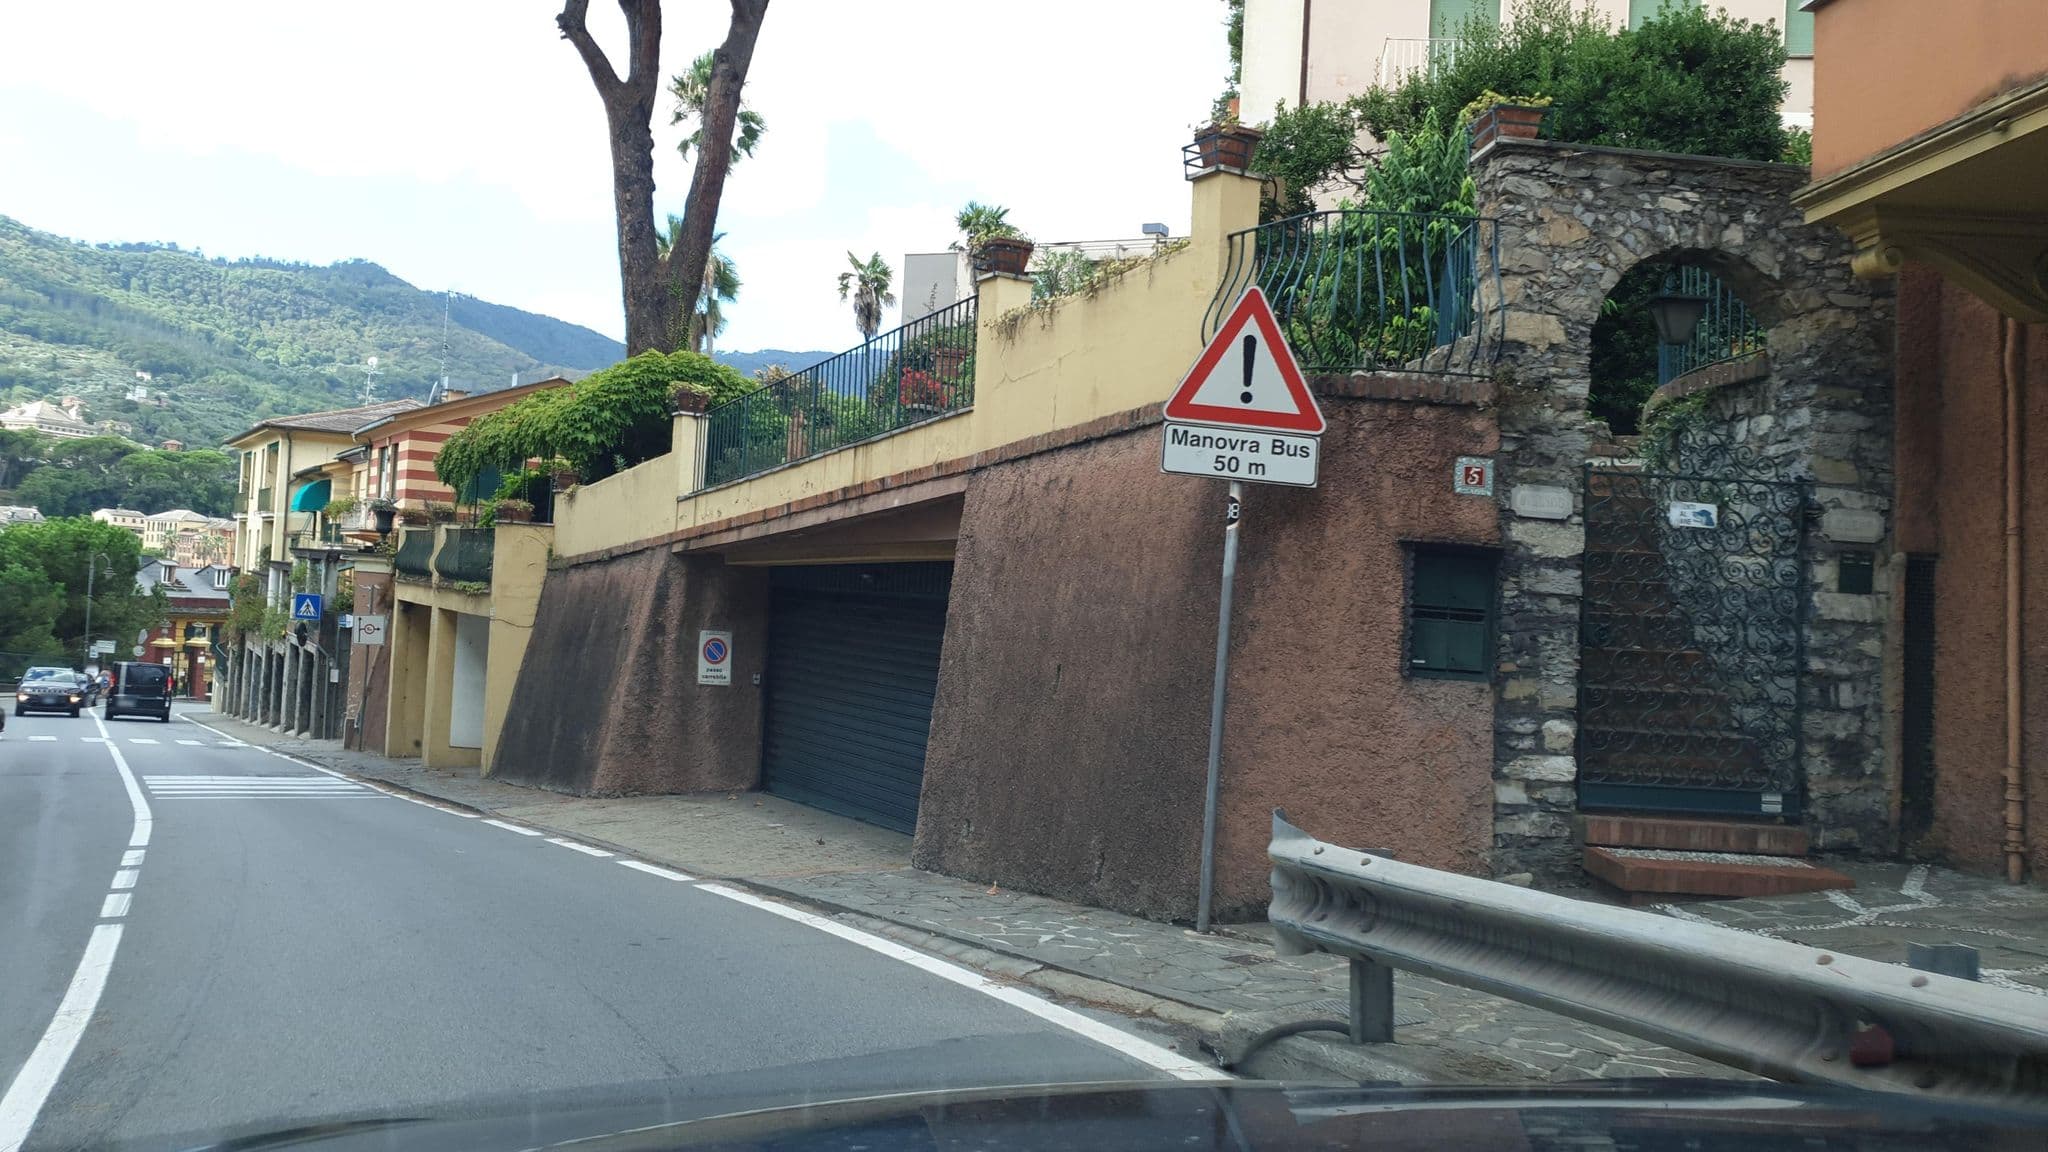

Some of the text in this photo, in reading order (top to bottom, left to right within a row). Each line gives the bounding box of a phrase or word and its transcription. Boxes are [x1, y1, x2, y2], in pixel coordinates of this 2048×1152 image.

[1171, 428, 1310, 458] Manovra Bus
[1213, 455, 1266, 476] 50 m
[1467, 467, 1481, 485] 5
